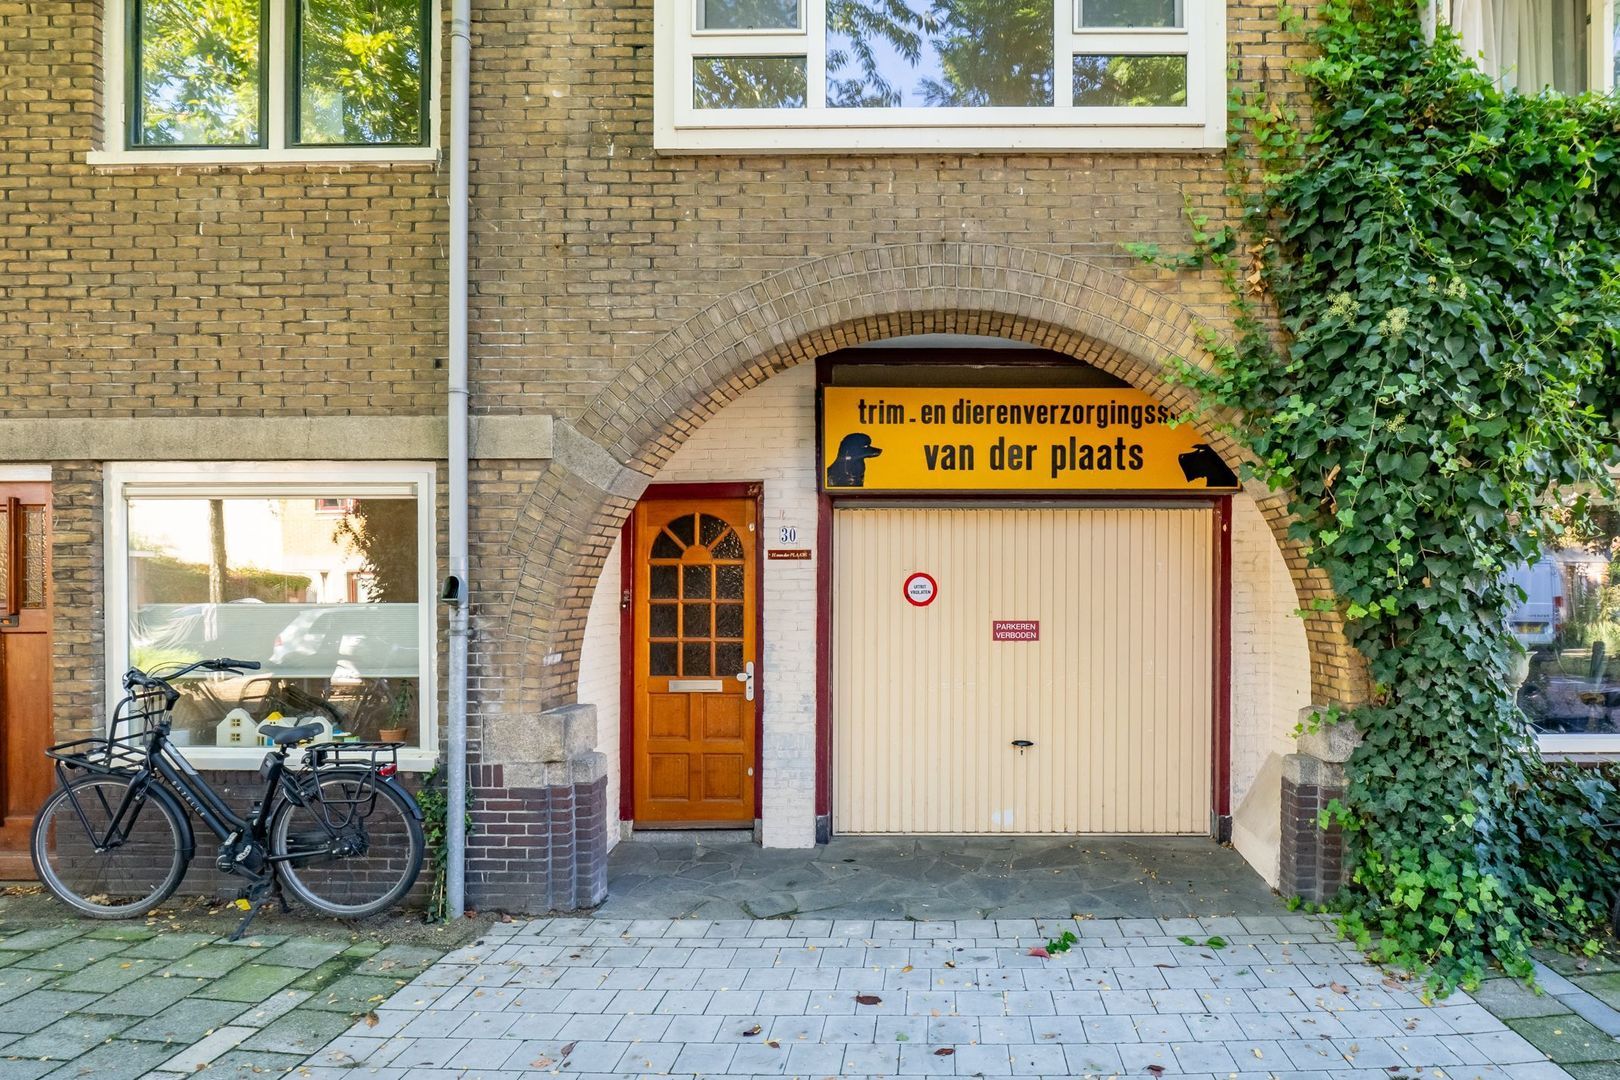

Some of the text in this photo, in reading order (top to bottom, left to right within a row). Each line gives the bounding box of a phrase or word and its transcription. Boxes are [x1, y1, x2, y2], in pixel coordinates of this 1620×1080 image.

[921, 404, 946, 425] en
[952, 398, 1180, 429] dierenverzorgingss
[924, 436, 1144, 479] van der plaats
[781, 527, 796, 543] 30
[996, 631, 1037, 639] VERBODEN
[171, 780, 206, 817] GAZELLE
